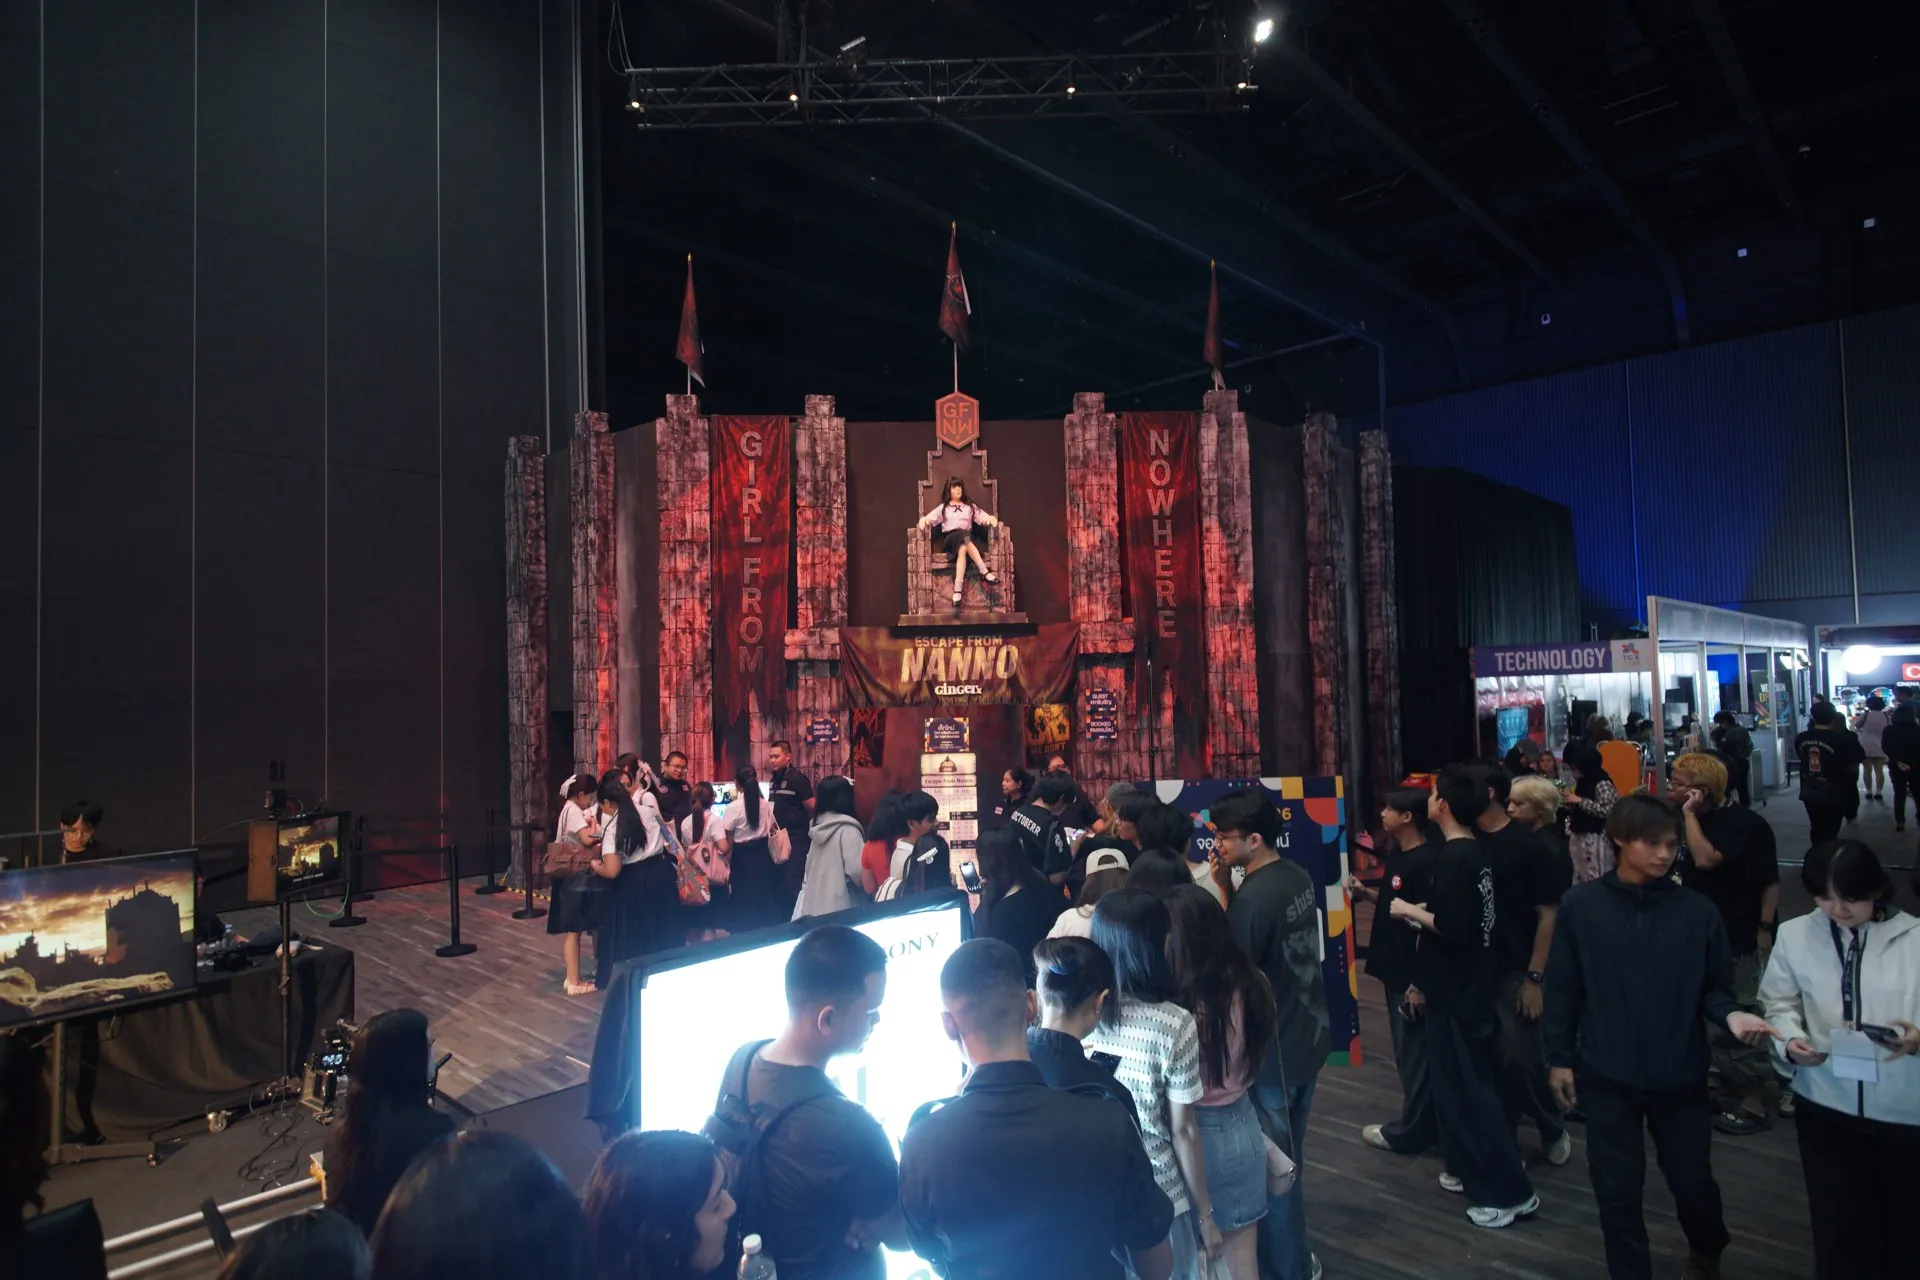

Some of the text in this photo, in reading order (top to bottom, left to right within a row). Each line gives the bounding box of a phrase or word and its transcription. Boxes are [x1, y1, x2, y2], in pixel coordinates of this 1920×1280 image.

[943, 402, 971, 418] GF
[1147, 429, 1176, 638] NOWHERE
[739, 431, 764, 673] GIRL FROM
[915, 635, 1003, 647] ESCAPE FROM
[901, 644, 1019, 682] NANNO
[1494, 647, 1606, 672] TECHNOLOGY
[1011, 810, 1042, 837] OCTOBERR
[884, 931, 939, 958] ONY
